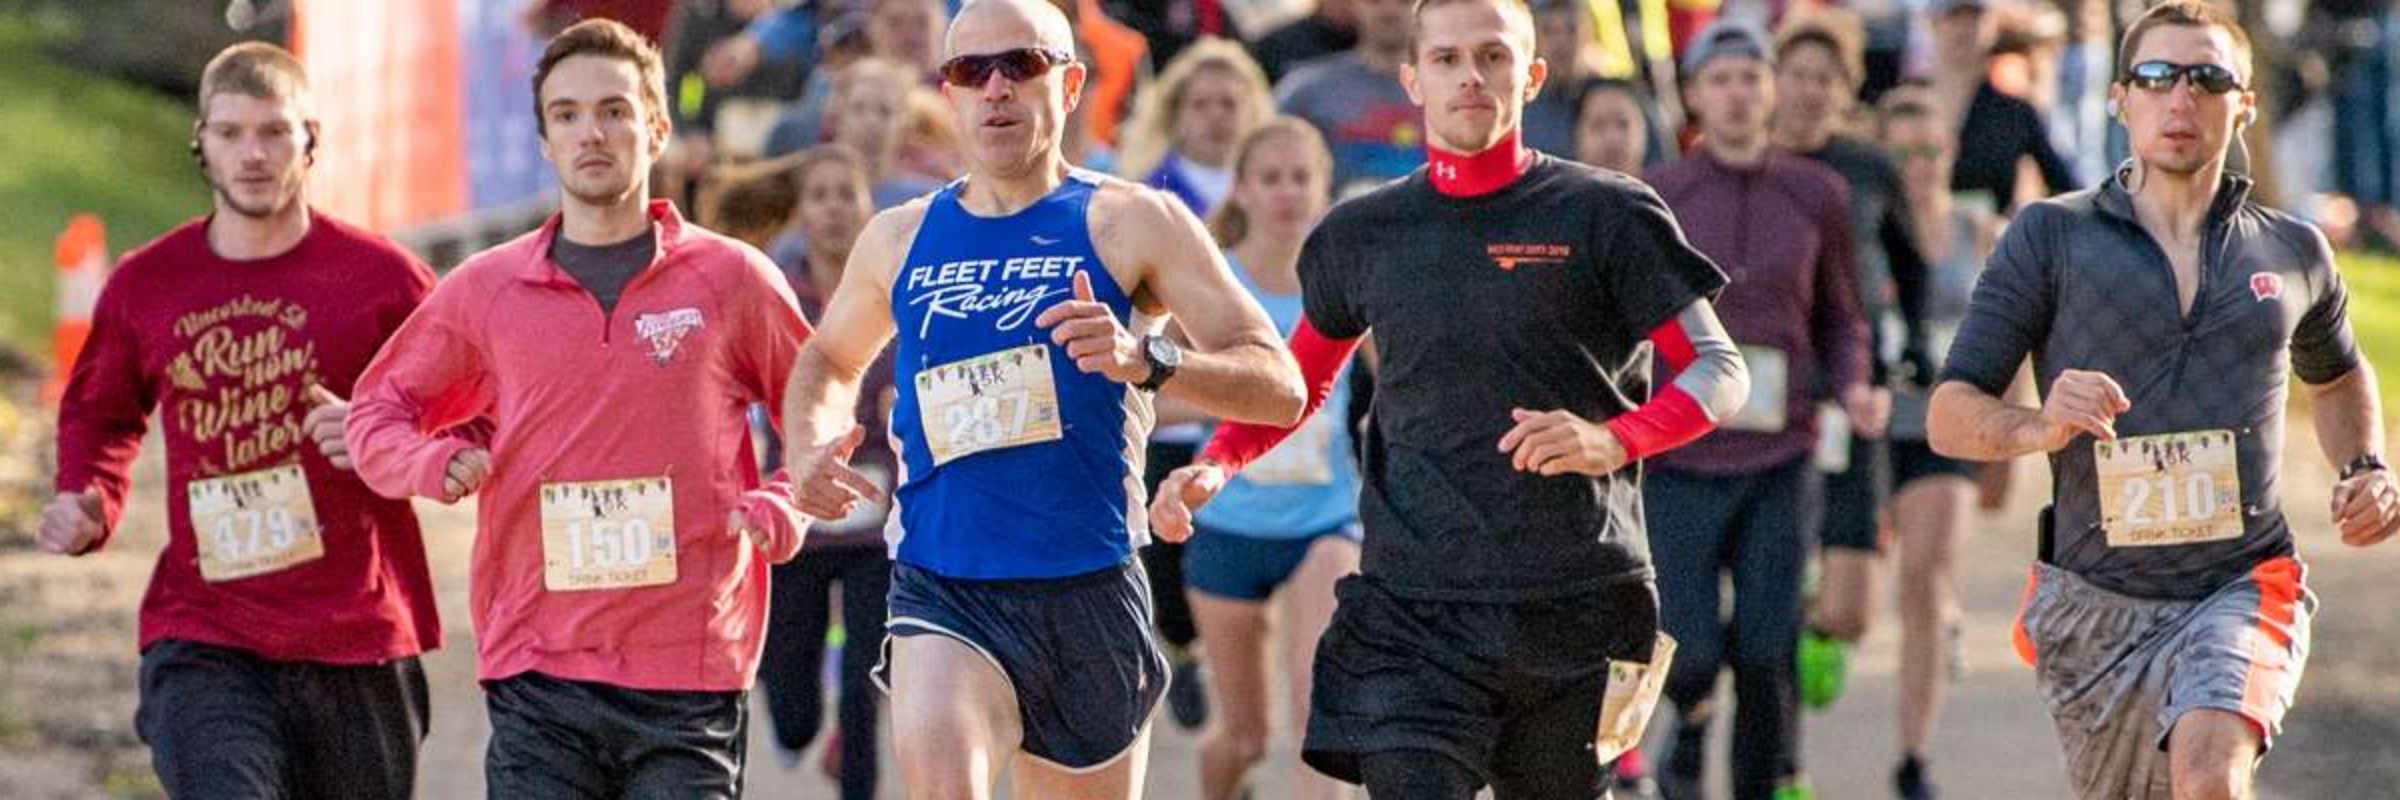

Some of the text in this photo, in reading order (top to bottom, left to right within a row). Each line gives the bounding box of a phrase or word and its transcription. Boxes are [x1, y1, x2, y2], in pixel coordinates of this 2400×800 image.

[907, 256, 1084, 291] FLEET FEET
[909, 283, 1070, 340] Racing
[194, 326, 286, 377] Run
[180, 385, 294, 441] Wine
[226, 412, 303, 469] later
[944, 388, 1029, 448] 287
[2123, 472, 2215, 525] 210
[210, 507, 294, 560] 479
[567, 512, 652, 573] 150
